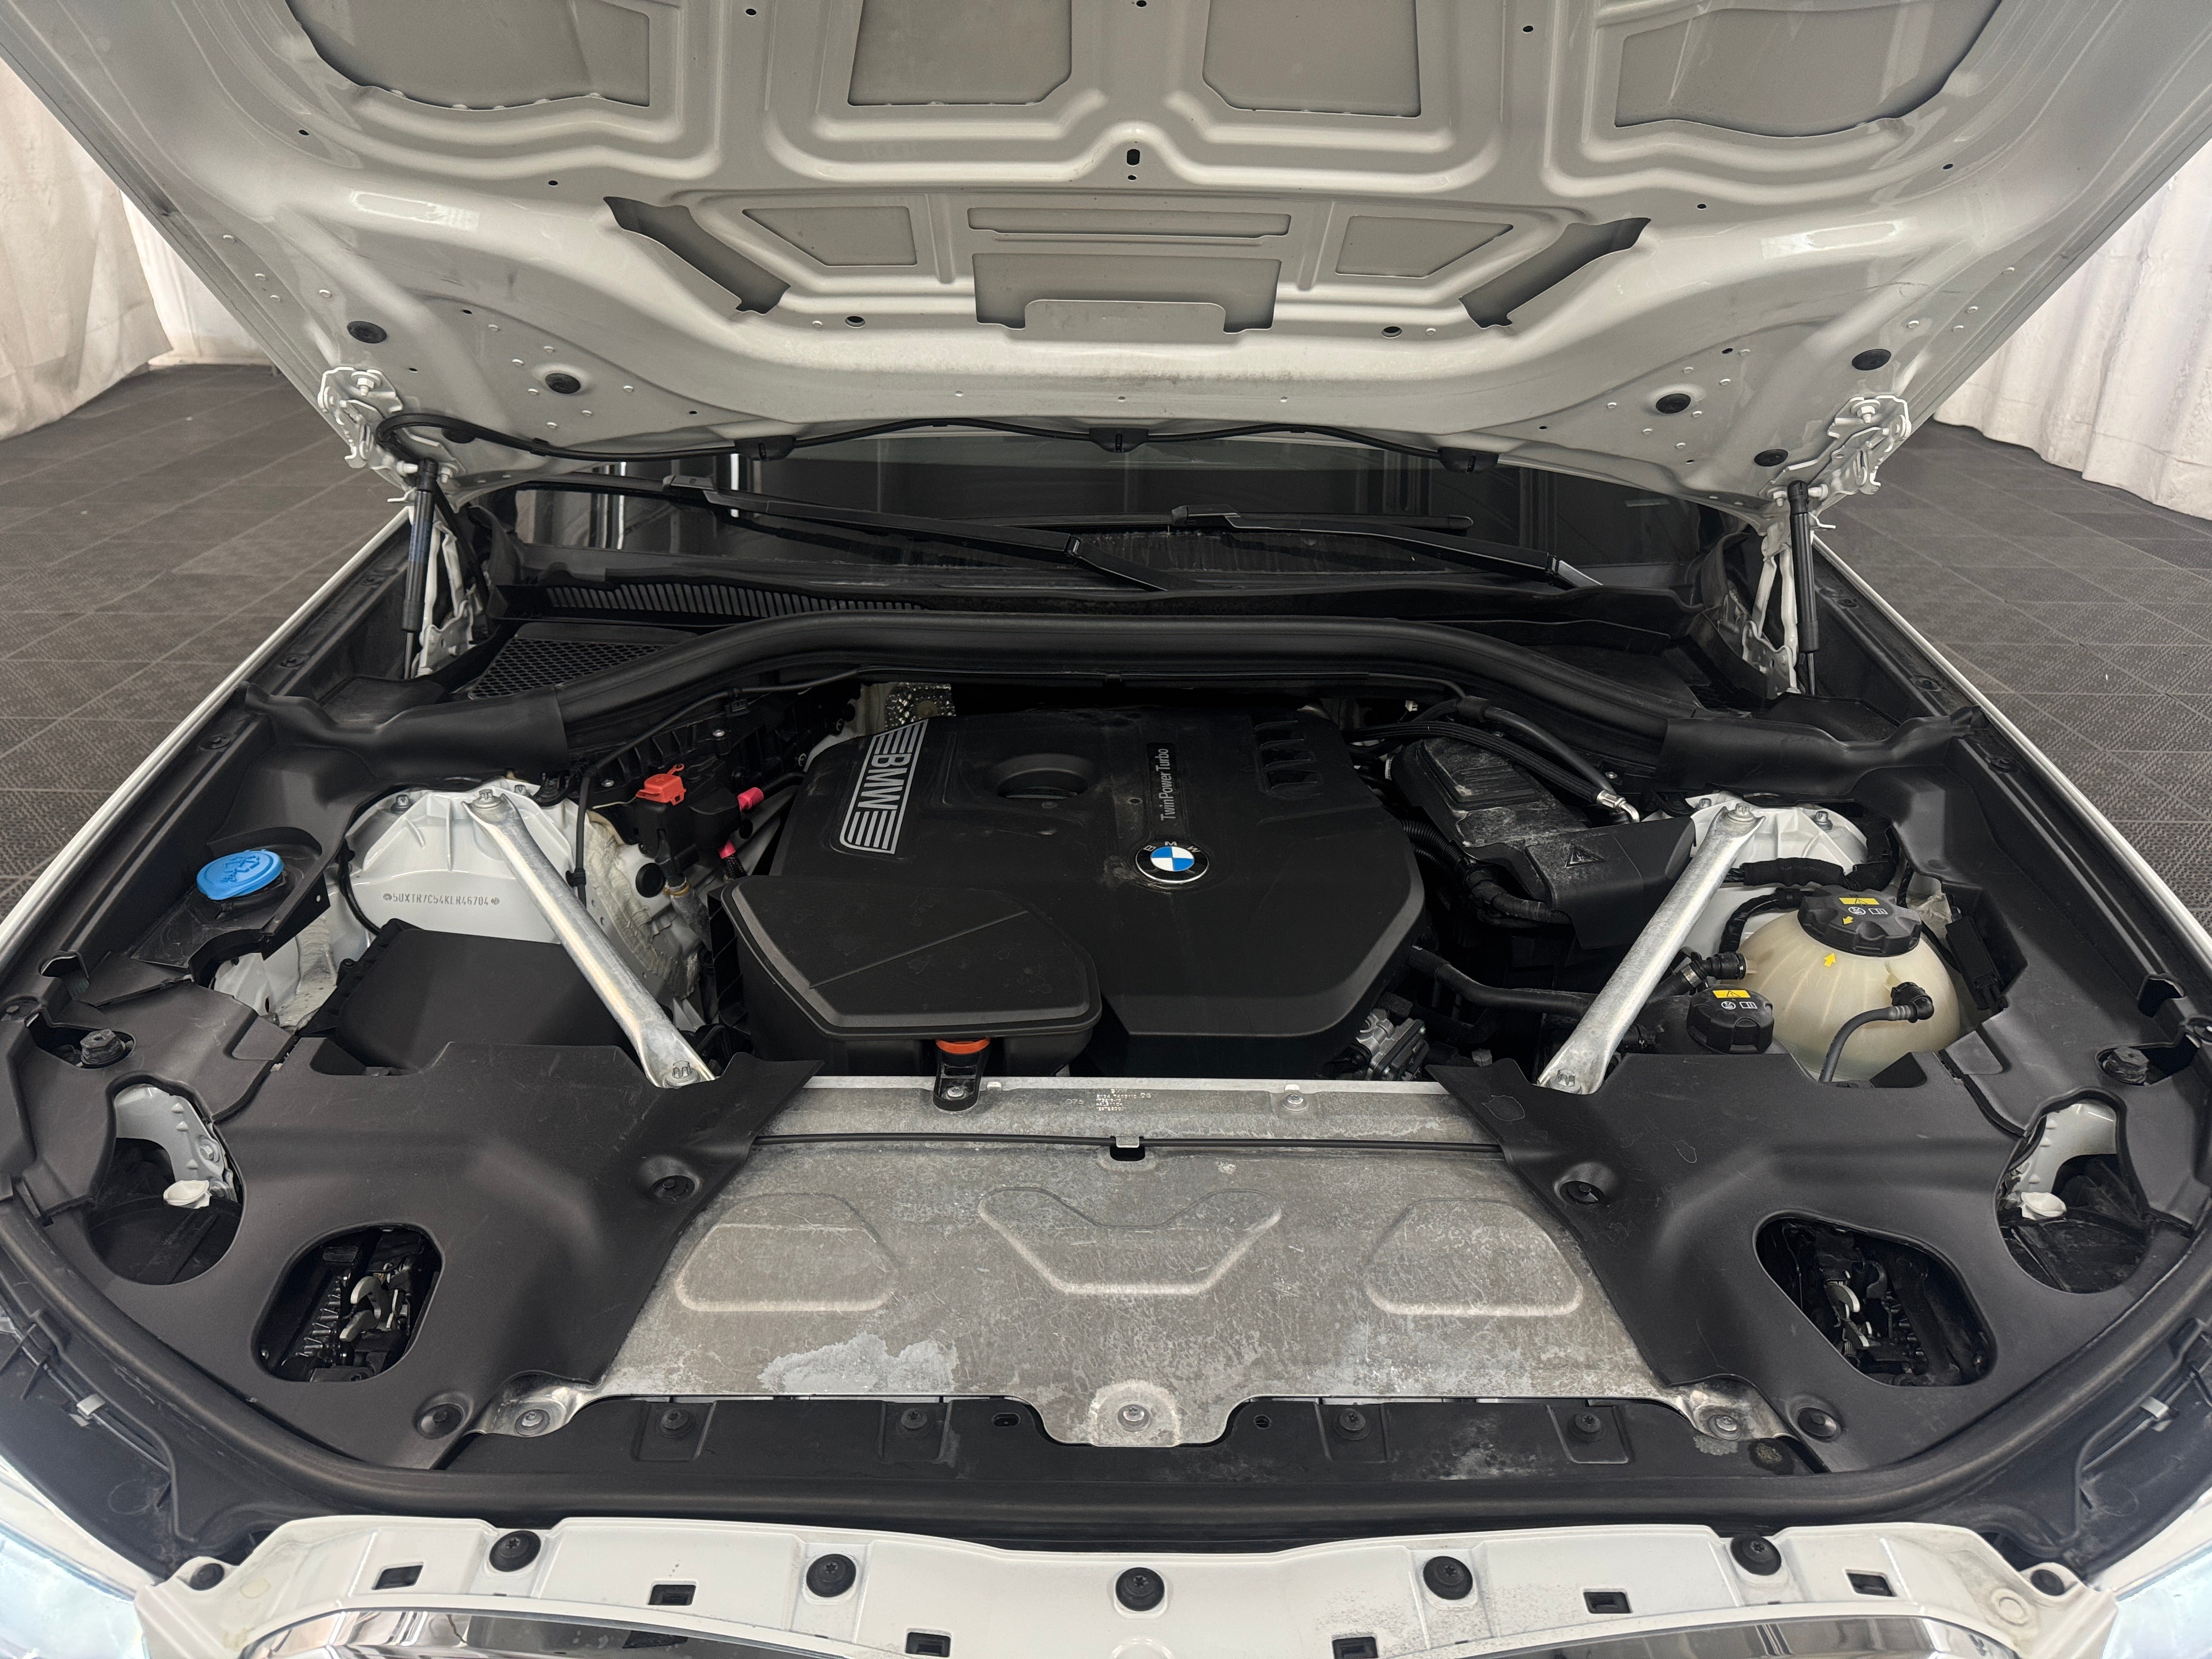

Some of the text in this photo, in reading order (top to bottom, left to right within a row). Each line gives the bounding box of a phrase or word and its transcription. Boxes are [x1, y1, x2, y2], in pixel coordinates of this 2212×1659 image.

[857, 753, 912, 810] BMW
[1154, 748, 1176, 821] TwinPower Turbo
